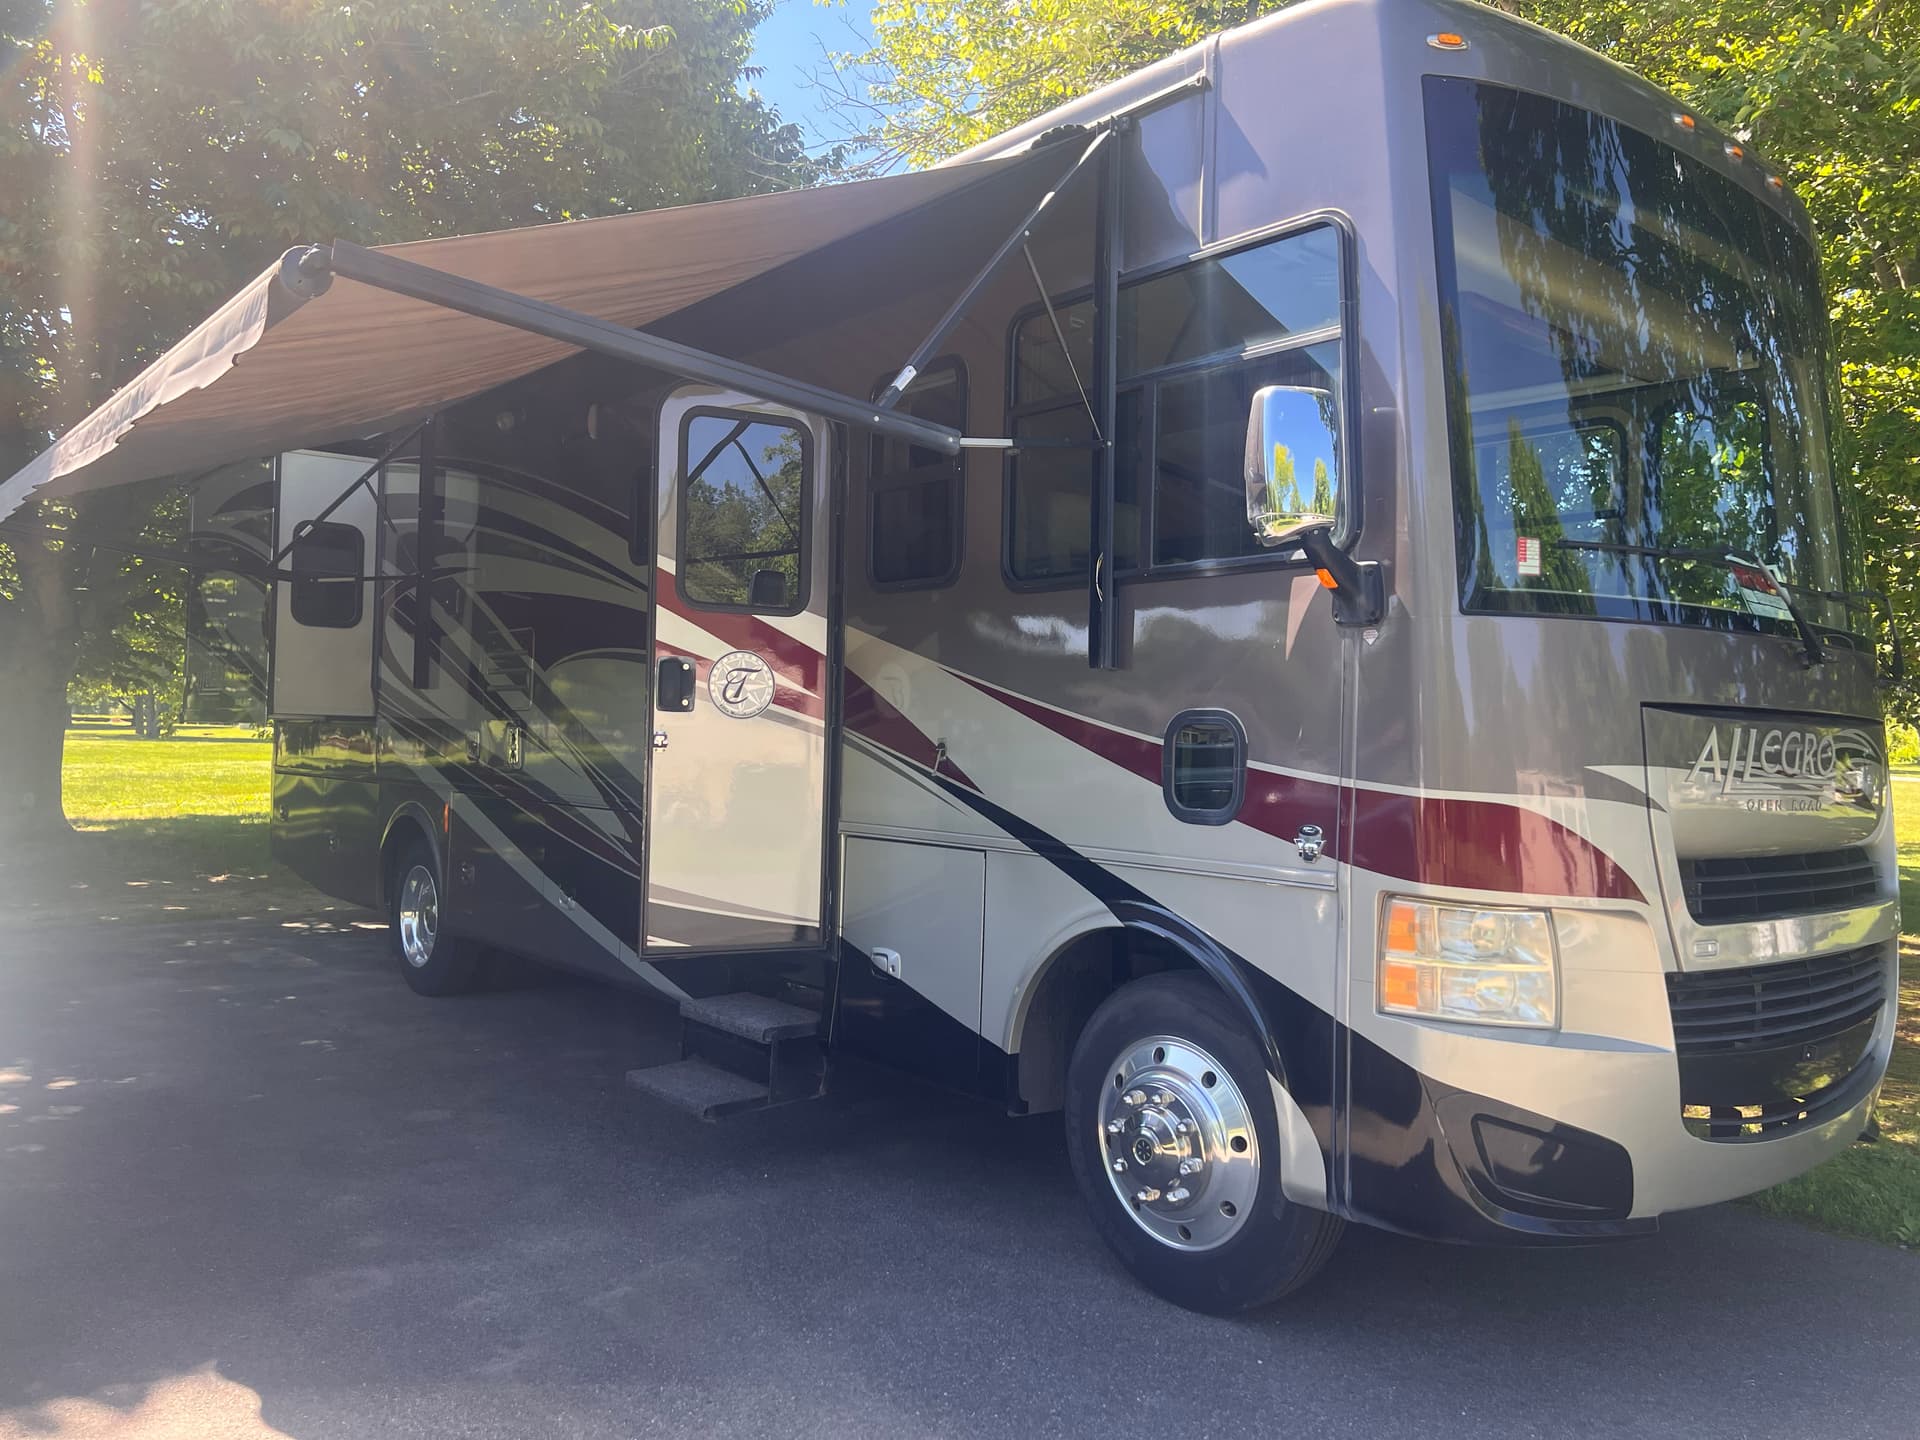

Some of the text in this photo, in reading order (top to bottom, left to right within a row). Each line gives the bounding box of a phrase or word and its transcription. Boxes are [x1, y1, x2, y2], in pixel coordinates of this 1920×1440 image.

[1684, 724, 1837, 795] ALLEGRO
[1746, 798, 1823, 812] OPEN ROAD
